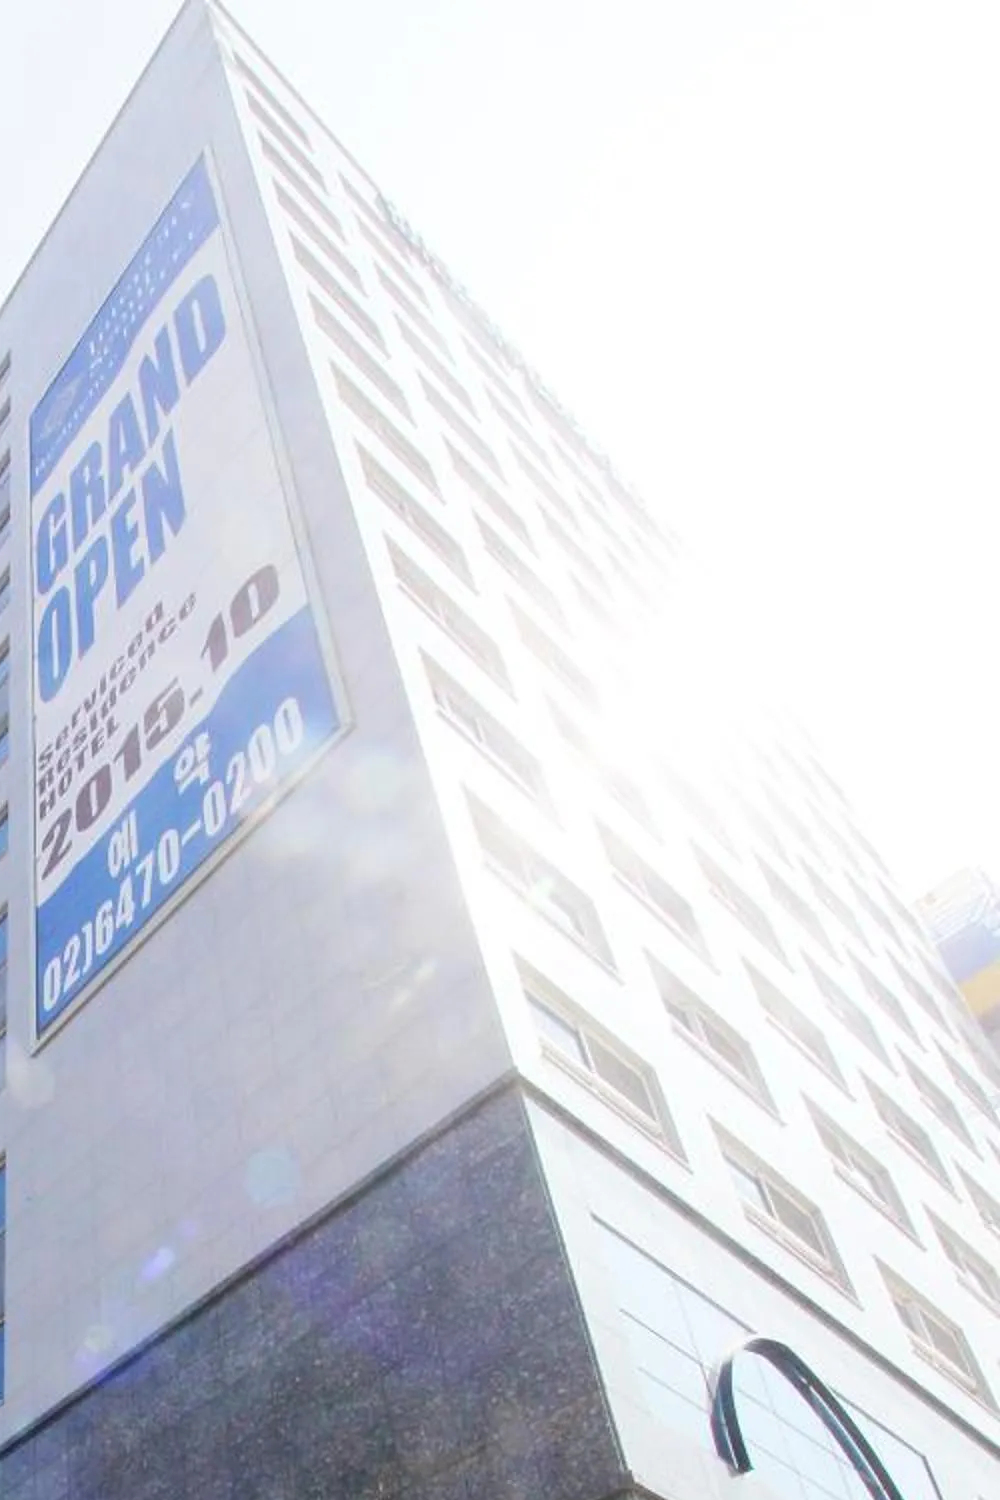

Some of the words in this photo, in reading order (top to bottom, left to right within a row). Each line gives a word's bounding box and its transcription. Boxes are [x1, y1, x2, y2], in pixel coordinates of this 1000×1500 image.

[36, 274, 226, 595] GRAND
[38, 427, 186, 703] OPEN
[39, 715, 120, 821] HOTEL
